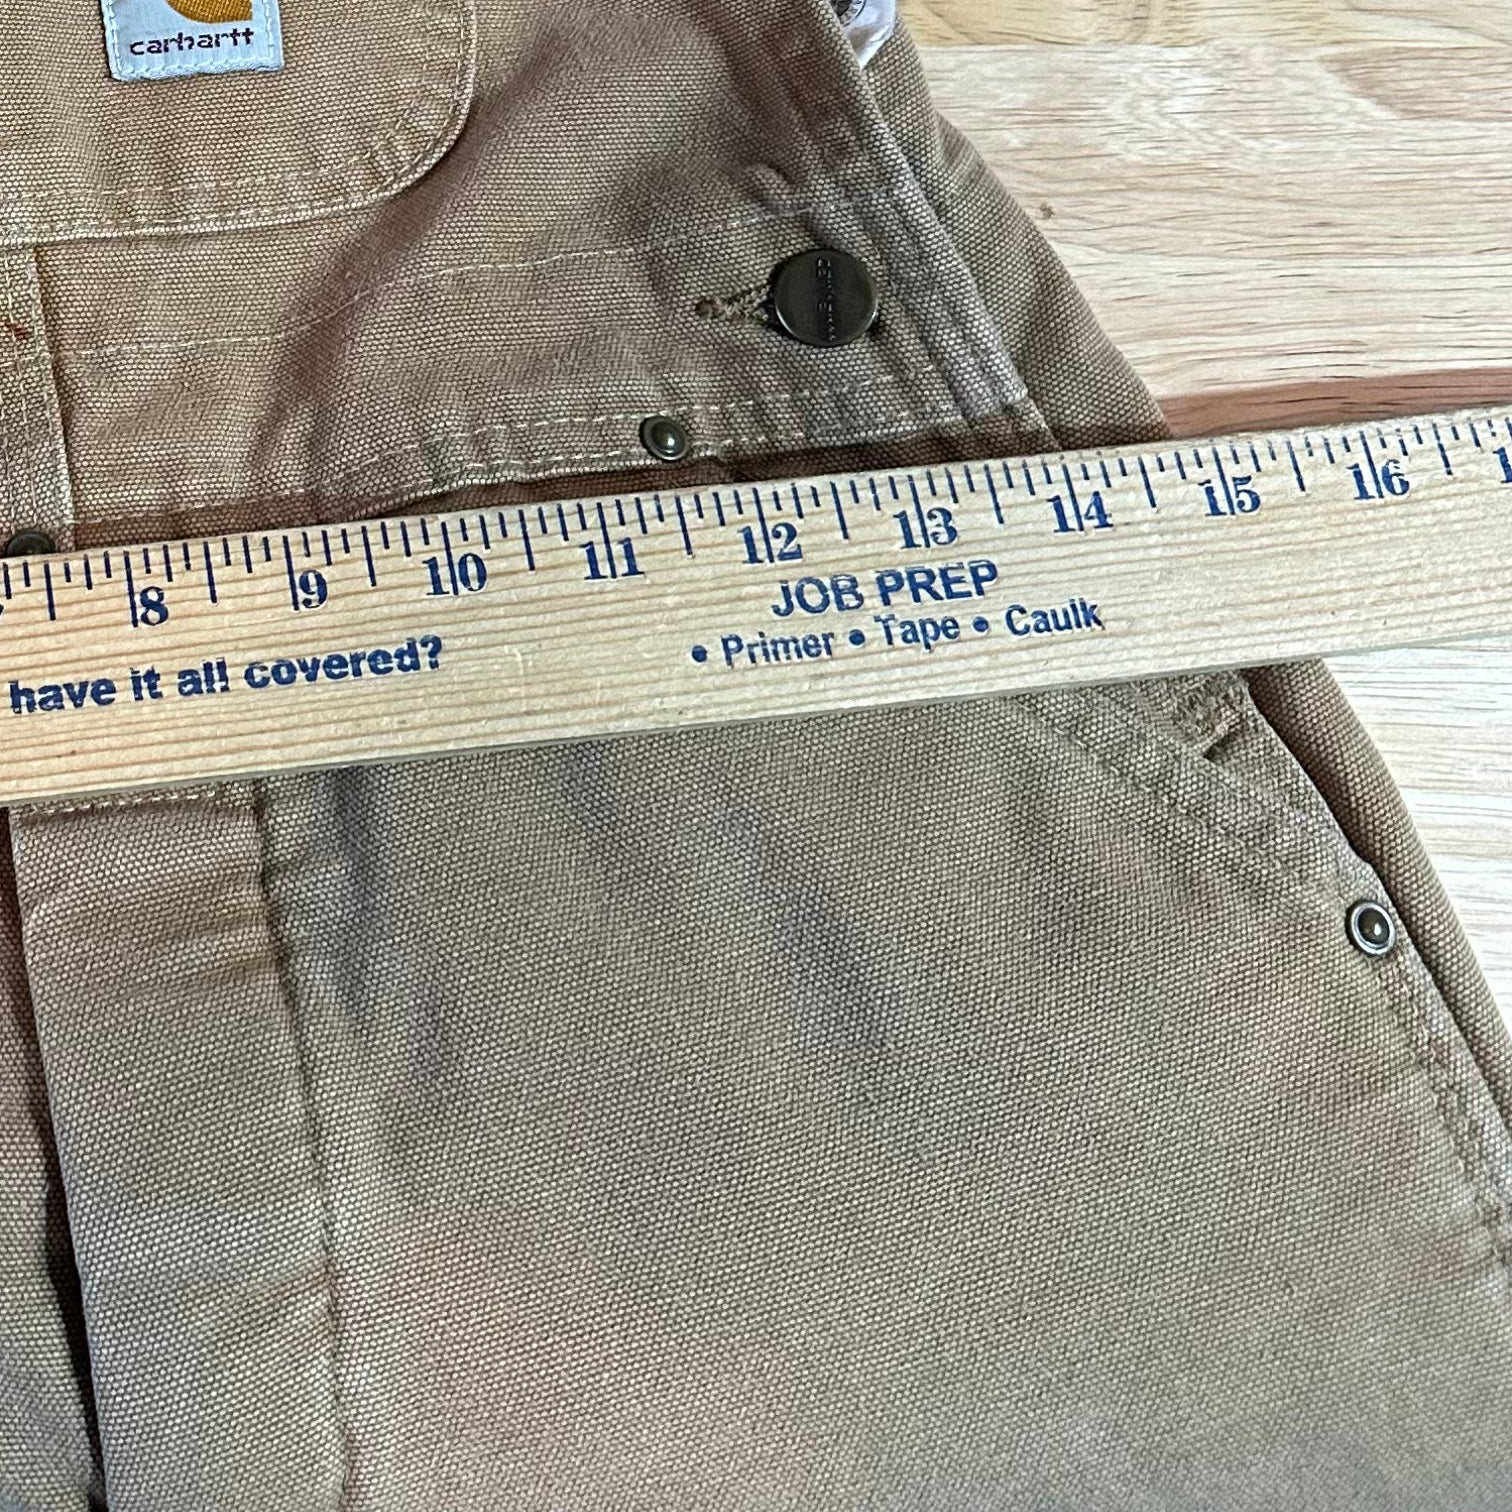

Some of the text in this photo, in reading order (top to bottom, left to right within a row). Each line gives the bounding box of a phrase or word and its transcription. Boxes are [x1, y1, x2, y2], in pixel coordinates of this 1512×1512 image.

[129, 27, 254, 56] carhartt
[139, 586, 170, 627] 8
[298, 569, 328, 610] 9
[421, 552, 488, 597] 10
[580, 536, 646, 581] 11
[738, 522, 804, 566] 12
[893, 507, 959, 550] 13
[1047, 491, 1114, 533] 14
[1198, 475, 1262, 516] 15
[1346, 458, 1410, 501] 16
[772, 559, 999, 618] JOB PREP
[720, 598, 1105, 667] Primer Tape Caulk
[9, 672, 117, 715] have
[129, 664, 165, 702] it
[177, 656, 230, 698] all
[244, 634, 443, 689] covered?
